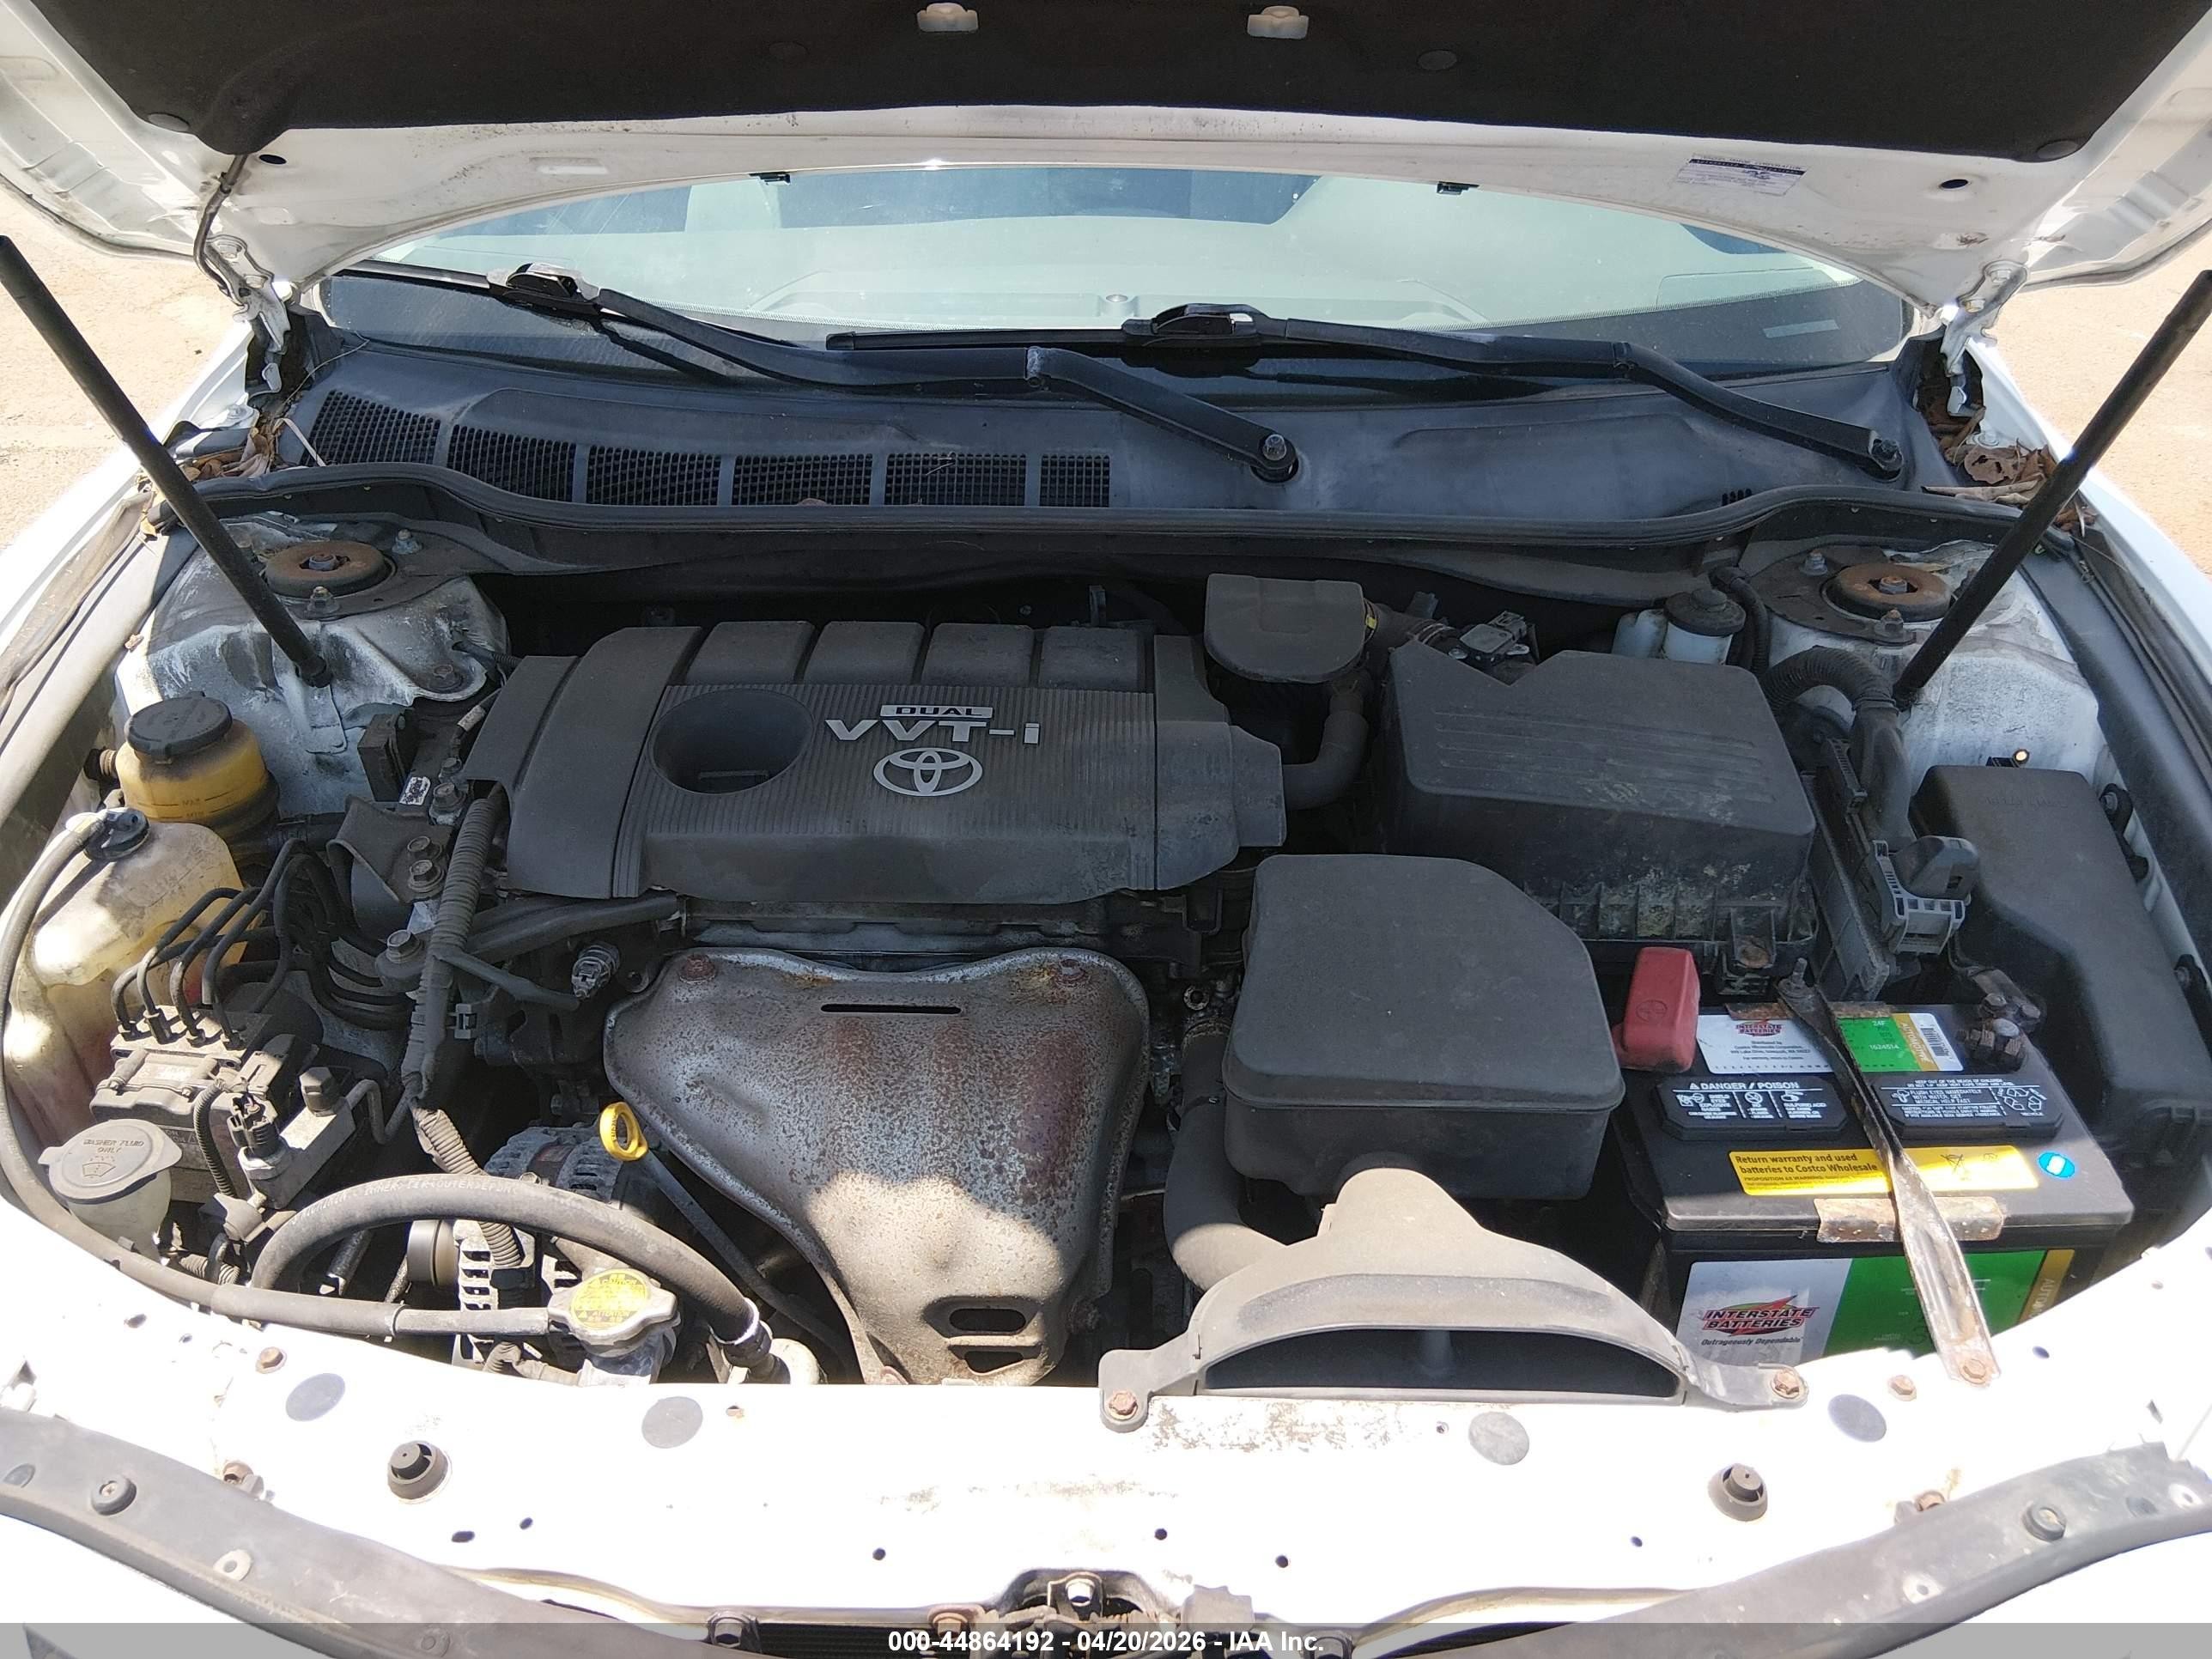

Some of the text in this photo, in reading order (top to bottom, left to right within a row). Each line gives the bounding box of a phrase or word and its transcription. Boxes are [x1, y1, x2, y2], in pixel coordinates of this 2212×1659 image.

[896, 707, 983, 716] DUAL
[824, 719, 1040, 744] VVT-i
[1735, 1155, 1767, 1164] Return
[1768, 1154, 1813, 1164] warranty
[1814, 1153, 1832, 1162] and
[1740, 1165, 1783, 1174] batteries
[1827, 1163, 1878, 1171] Wholesale
[1705, 1308, 1814, 1320] INTERSTATE
[1707, 1318, 1802, 1329] BATTERIES
[1701, 1336, 1801, 1346] Outrageously Dependable
